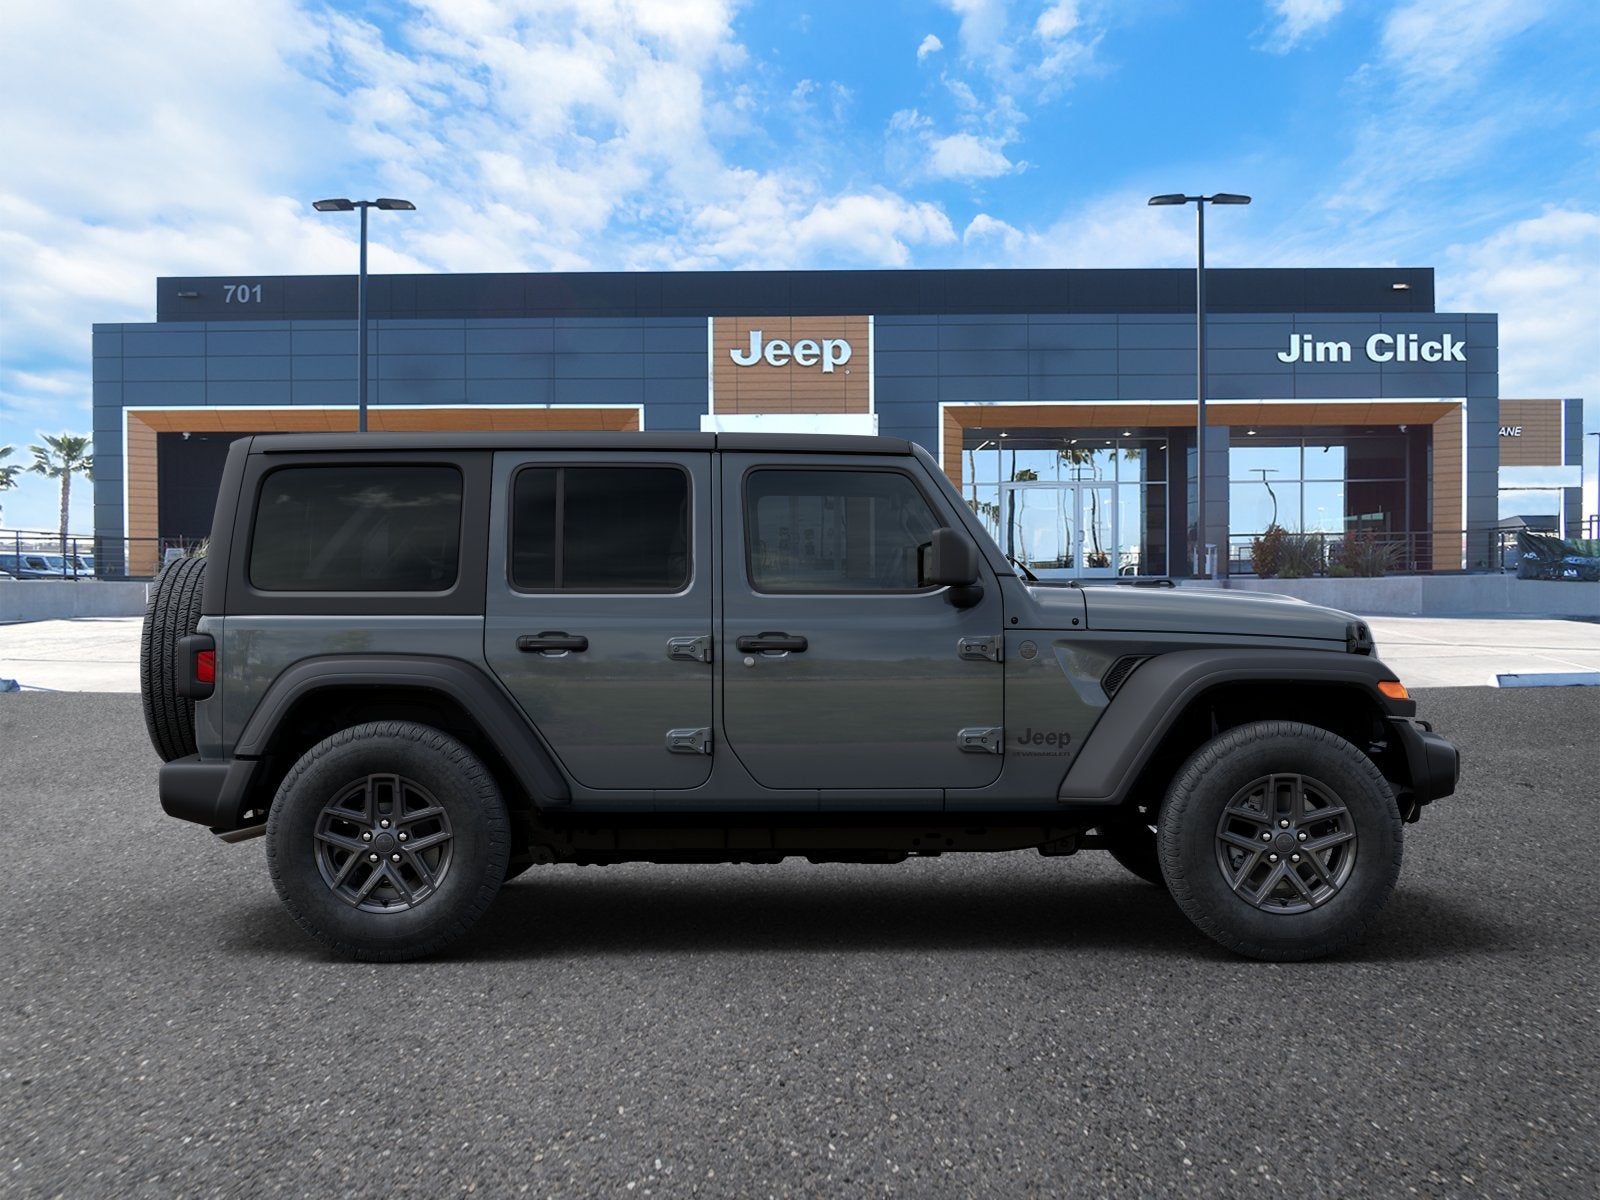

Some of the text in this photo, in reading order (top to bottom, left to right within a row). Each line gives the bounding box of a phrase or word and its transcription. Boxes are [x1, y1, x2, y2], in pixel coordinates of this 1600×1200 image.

[223, 284, 262, 304] 701
[729, 330, 852, 373] Jeep
[1277, 333, 1467, 363] Jim Click
[1017, 727, 1072, 749] Jeep
